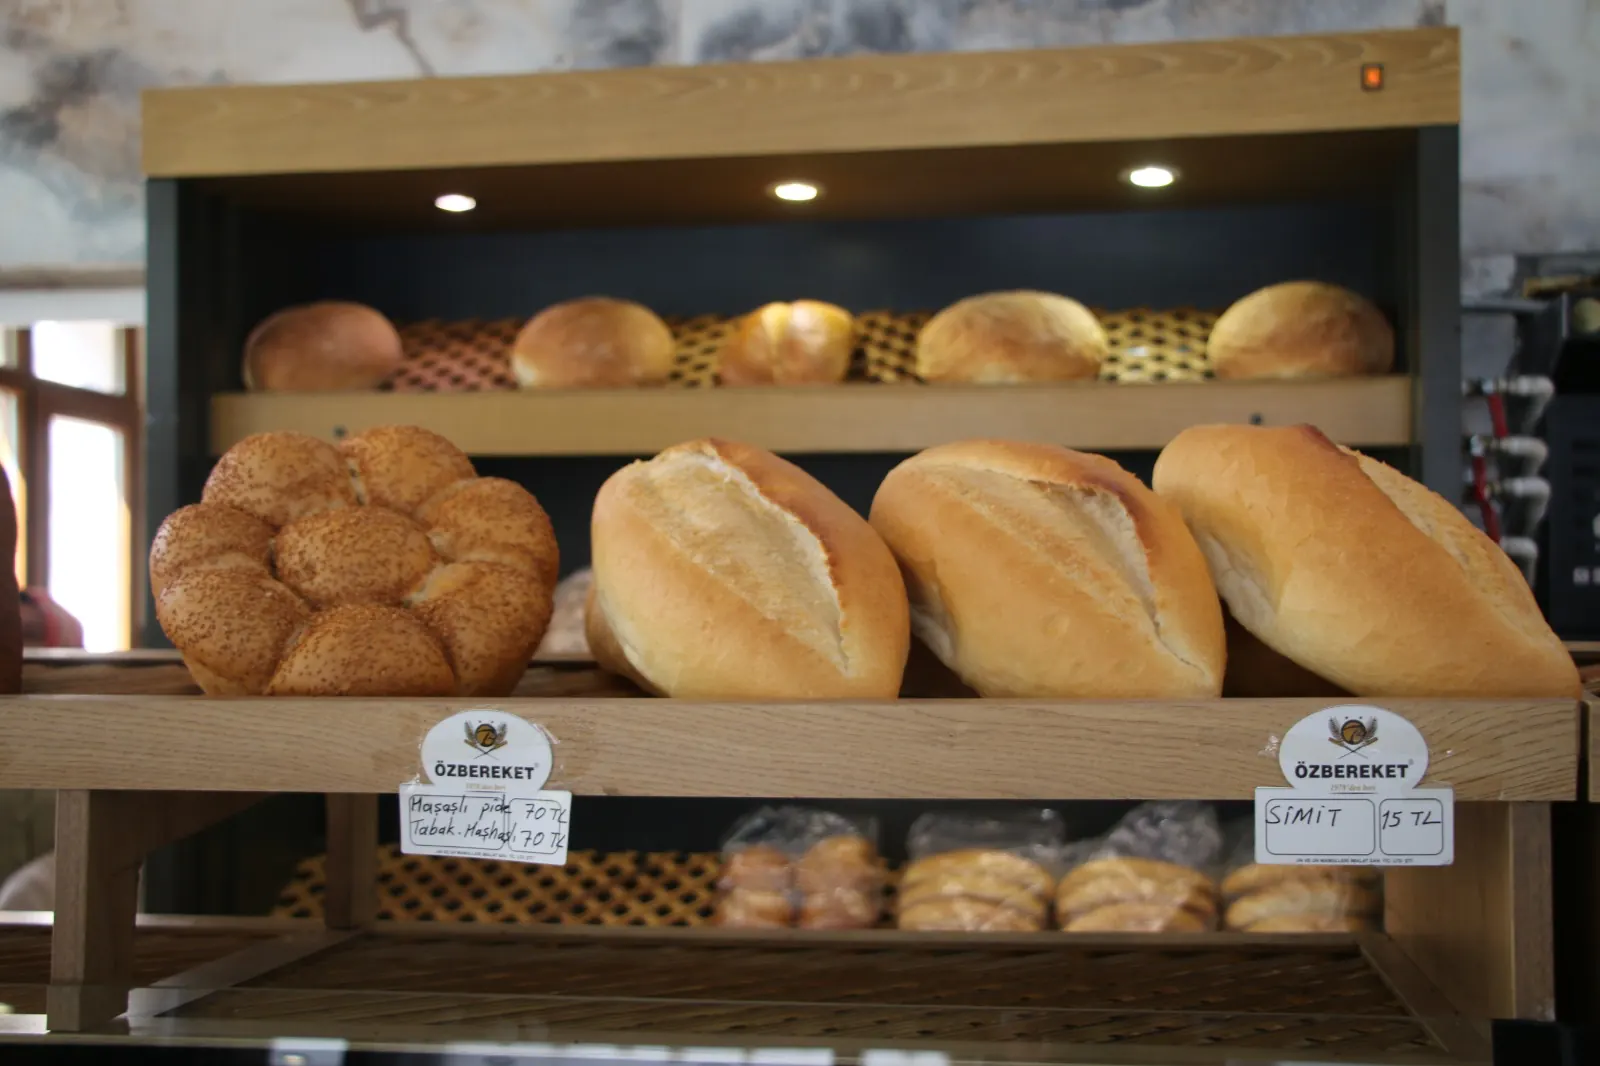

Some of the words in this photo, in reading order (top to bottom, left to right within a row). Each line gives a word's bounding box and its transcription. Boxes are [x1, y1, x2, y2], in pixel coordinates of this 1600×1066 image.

[435, 760, 535, 779] ÖZBEREKET
[1295, 761, 1409, 779] ÖZBEREKET
[525, 803, 546, 820] 70
[550, 808, 568, 824] TL
[1382, 810, 1403, 830] 15
[1411, 811, 1442, 827] TL
[520, 830, 545, 848] 70
[551, 831, 566, 848] TL
